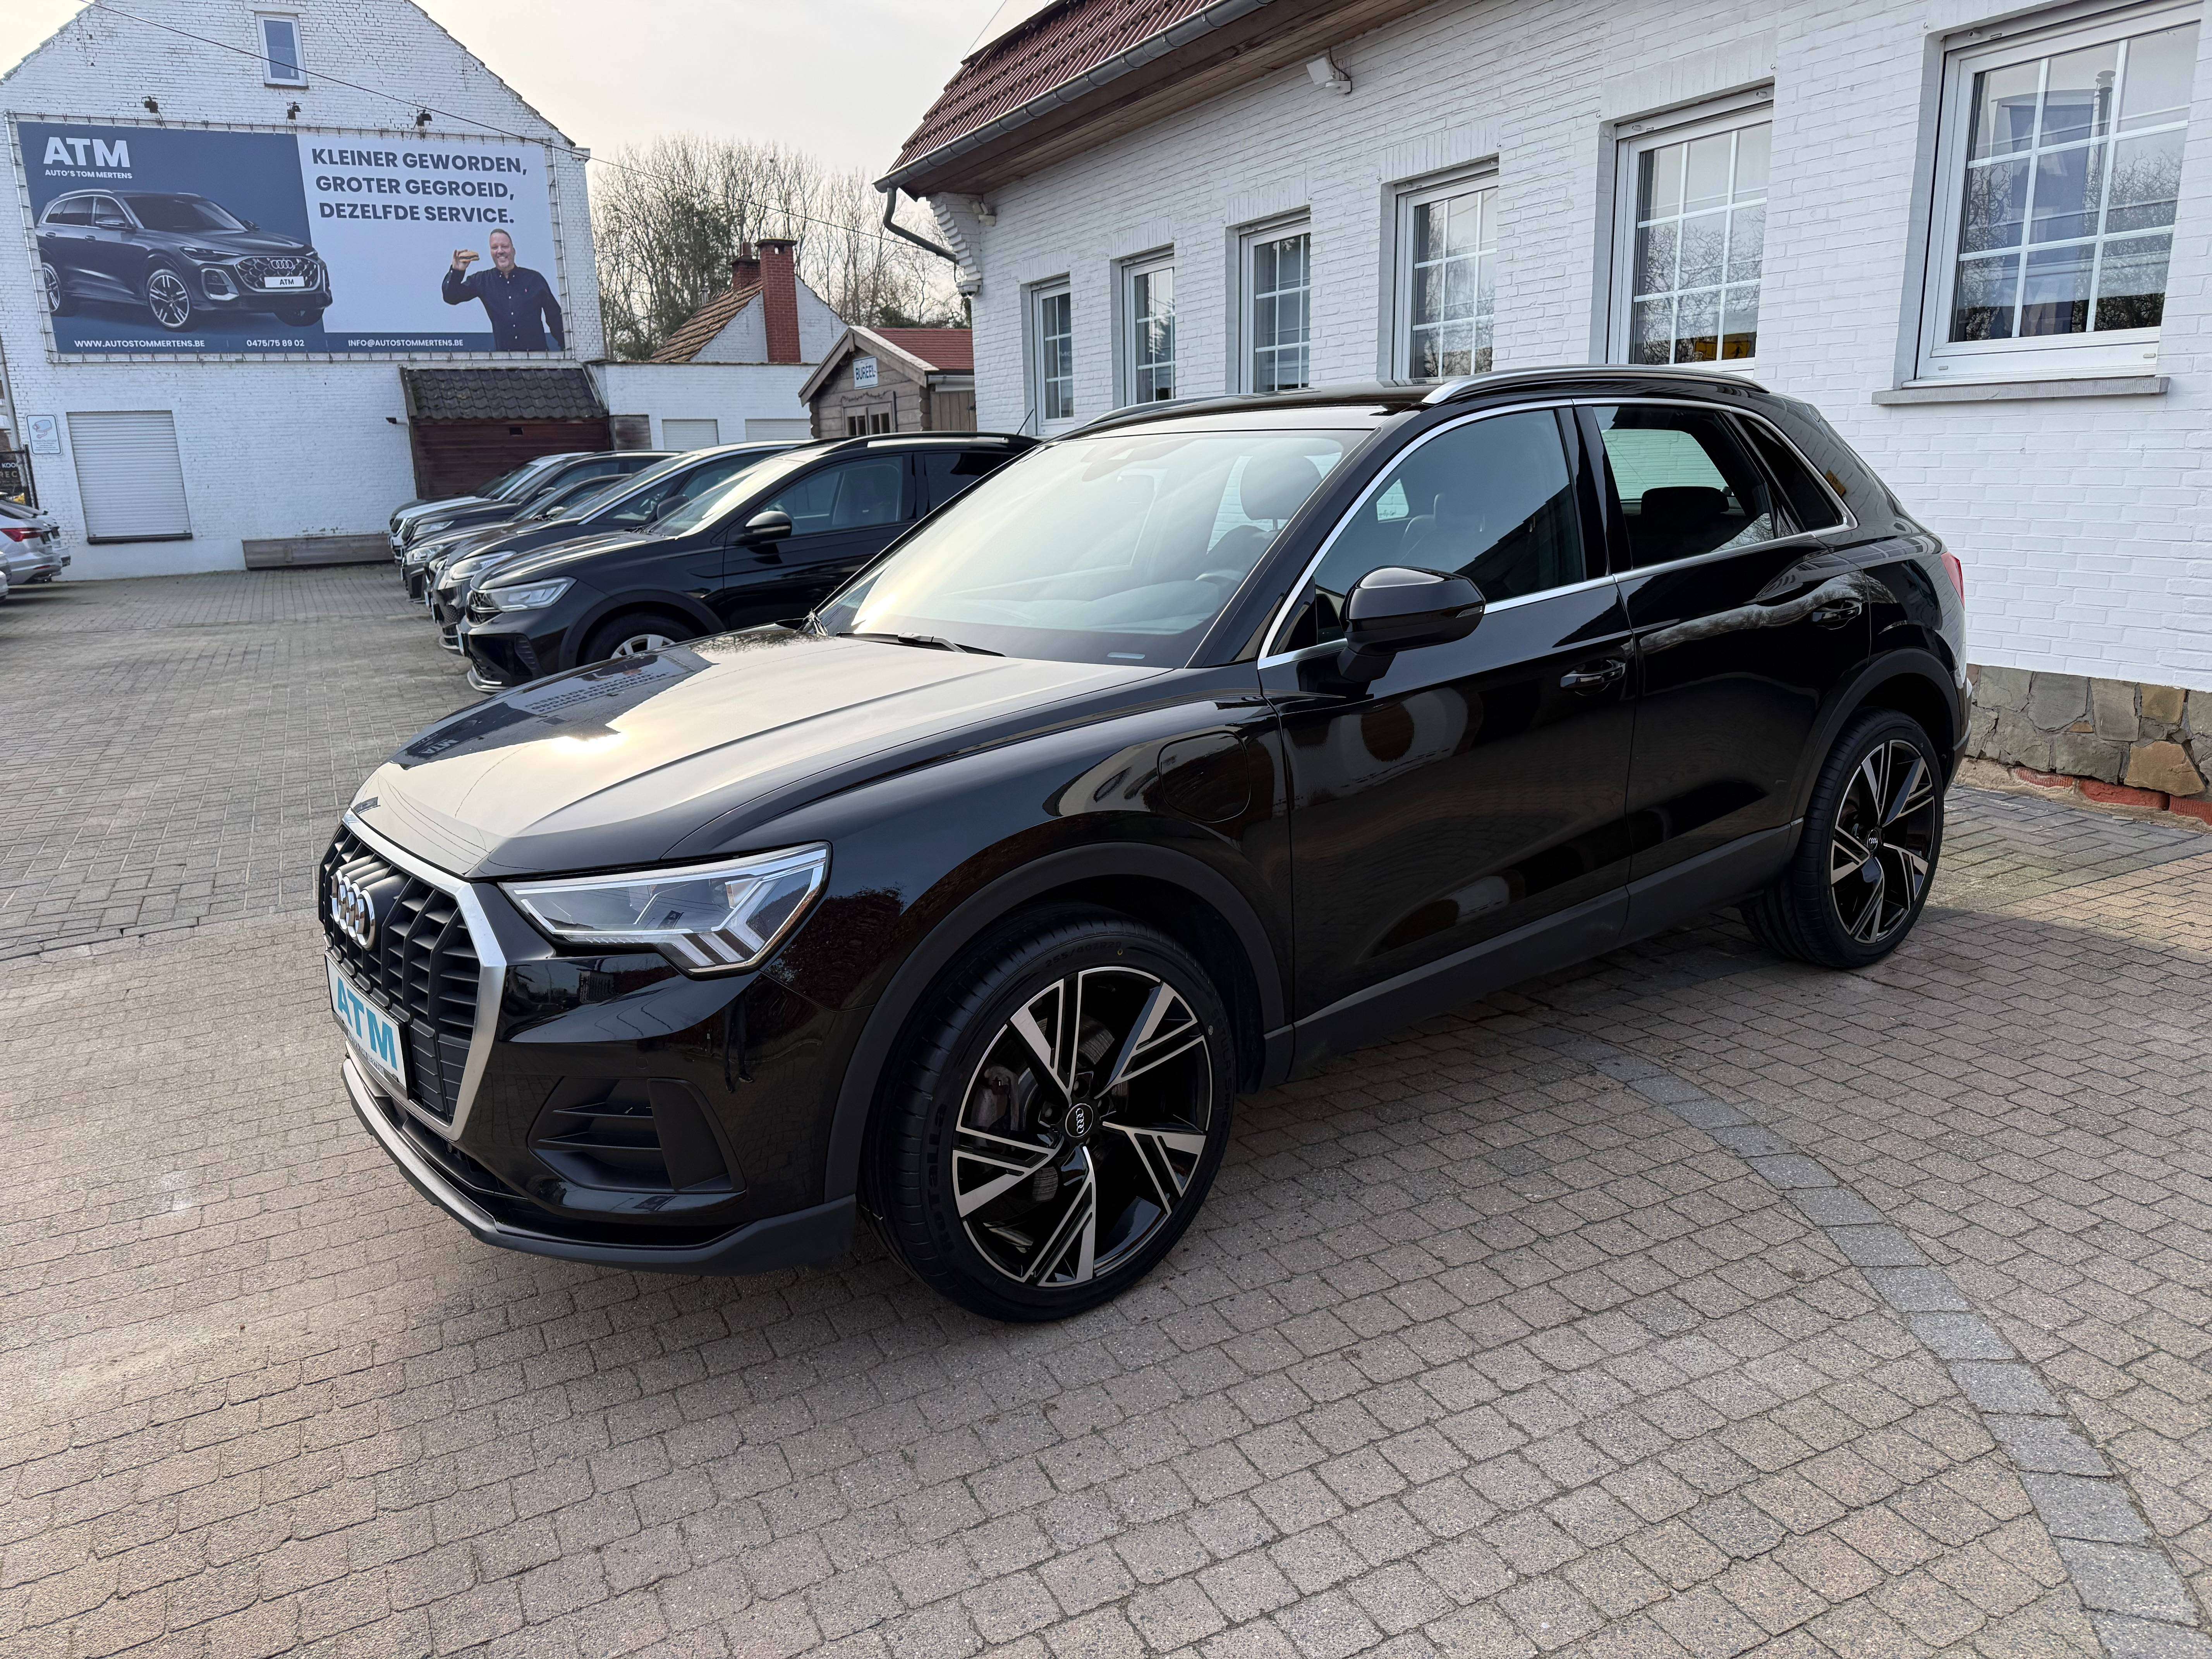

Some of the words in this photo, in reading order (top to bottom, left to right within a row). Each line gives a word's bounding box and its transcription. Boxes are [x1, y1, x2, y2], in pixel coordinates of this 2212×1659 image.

[43, 137, 131, 167] ATM
[312, 148, 398, 167] KLEINER
[403, 153, 527, 175] GEWORDEN,
[316, 176, 401, 194] GROTER
[405, 179, 514, 201] GEGROEID,
[319, 203, 420, 220] DEZELFDE
[424, 206, 514, 223] SERVICE.
[338, 976, 397, 1071] ATM
